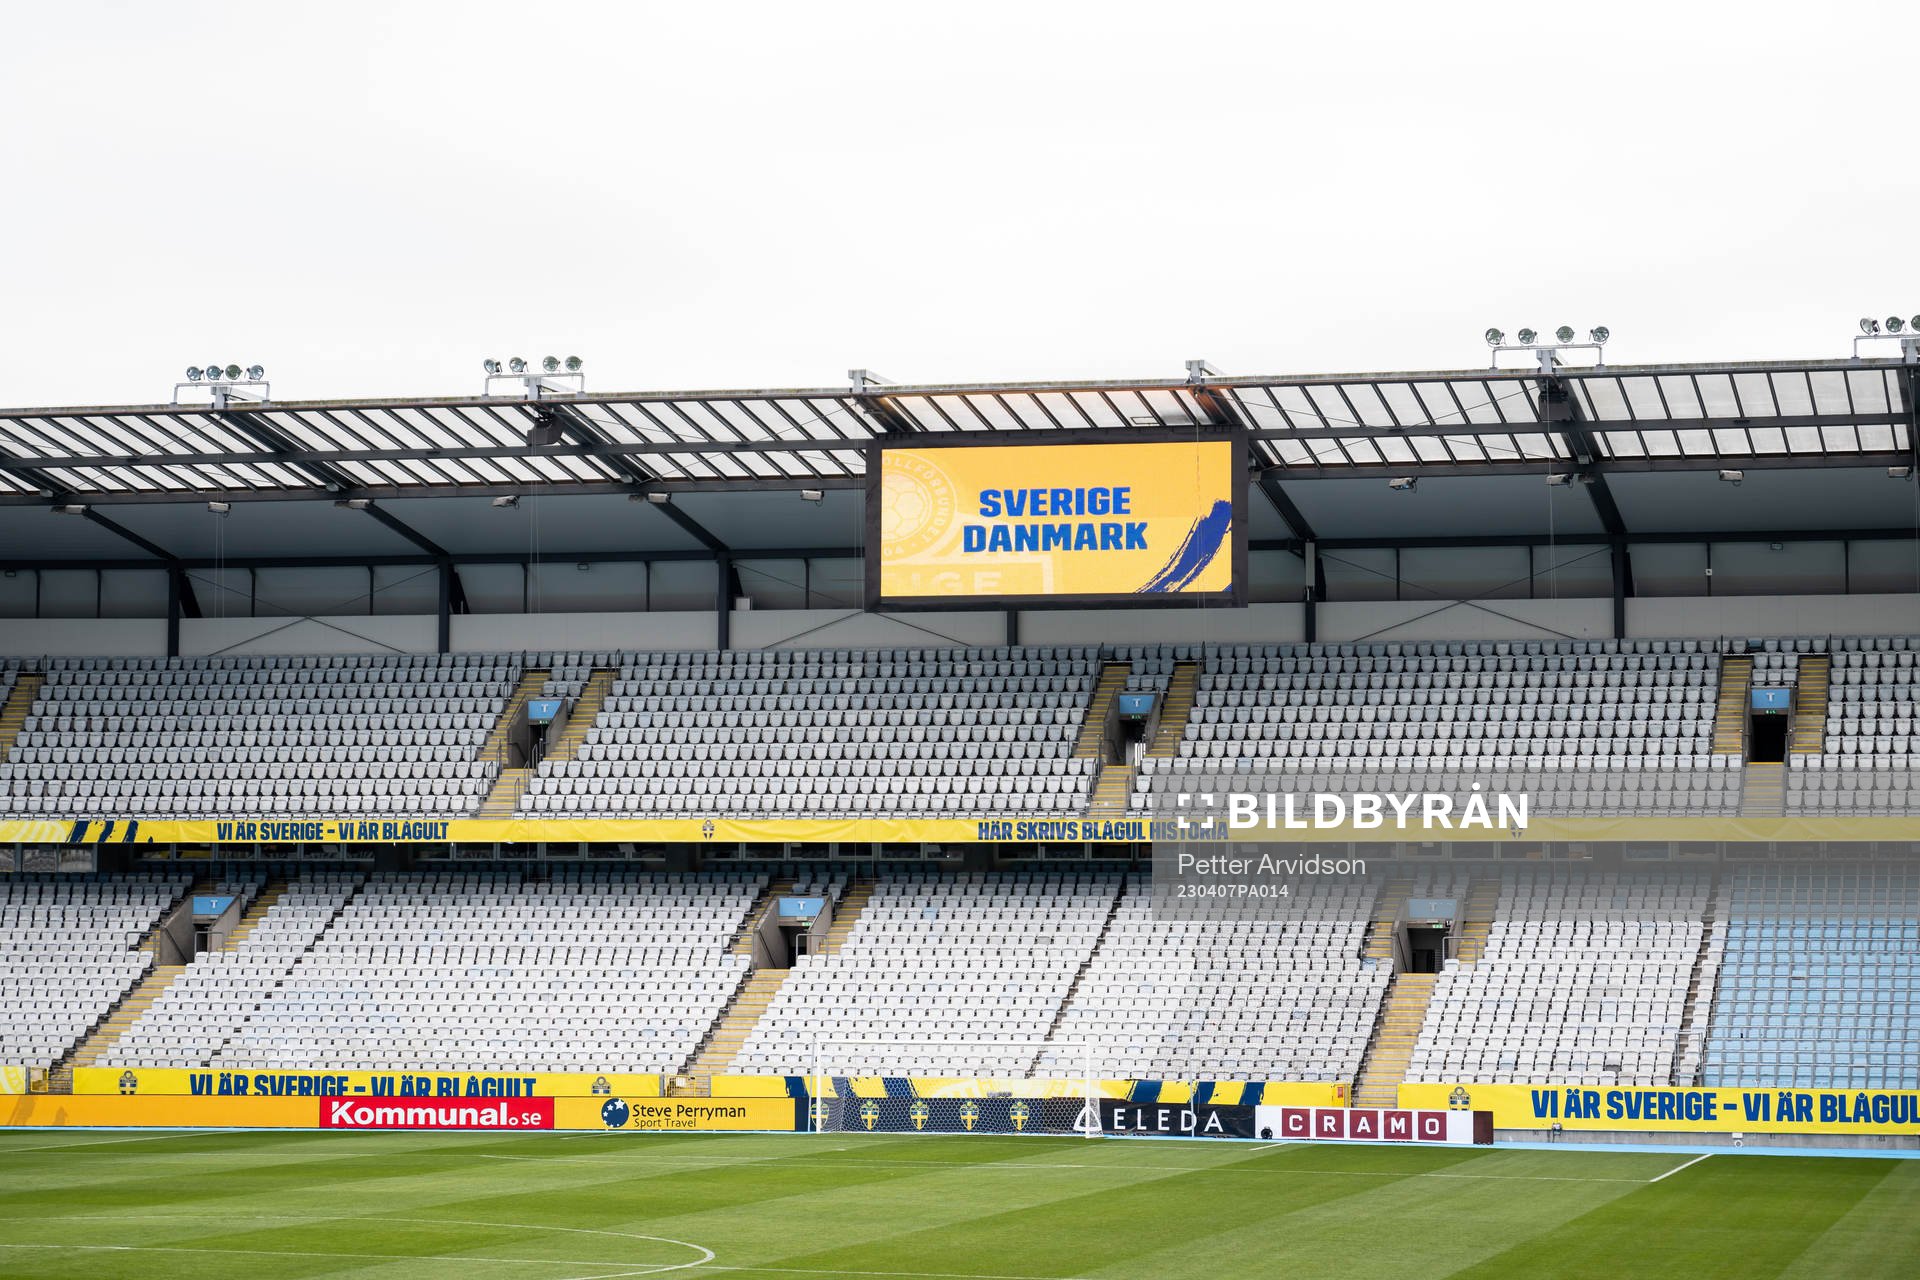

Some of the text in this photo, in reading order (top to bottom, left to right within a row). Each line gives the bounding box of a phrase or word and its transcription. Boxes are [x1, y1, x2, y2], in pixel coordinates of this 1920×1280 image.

[980, 487, 1130, 517] SVERIGE
[963, 522, 1147, 553] DANMARK
[217, 823, 232, 840] VI
[235, 821, 257, 840] ÄR
[260, 822, 323, 840] SVERIGE
[338, 823, 354, 840] VI
[357, 821, 379, 840] ÄR
[382, 821, 448, 841] BLÅGULT
[978, 820, 1229, 841] HÄR SKRIVS BLÅGUL HISTORIA
[190, 1074, 212, 1095] VI
[218, 1072, 248, 1095] ÄR
[254, 1074, 348, 1096] SVERIGE
[371, 1077, 394, 1096] VI
[400, 1075, 431, 1096] ÄR
[632, 1104, 746, 1119] Steve Perryman
[1531, 1090, 1558, 1118] VI
[1564, 1088, 1600, 1119] ÄR
[1607, 1091, 1717, 1121] SVERIGE
[1743, 1093, 1770, 1121] VI
[1776, 1091, 1813, 1122] ÄR
[1820, 1092, 1920, 1124] BLÅGUL
[634, 1117, 697, 1129] Sport Travel
[1113, 1108, 1223, 1133] ELEDA
[1289, 1114, 1439, 1135] CRAMO
